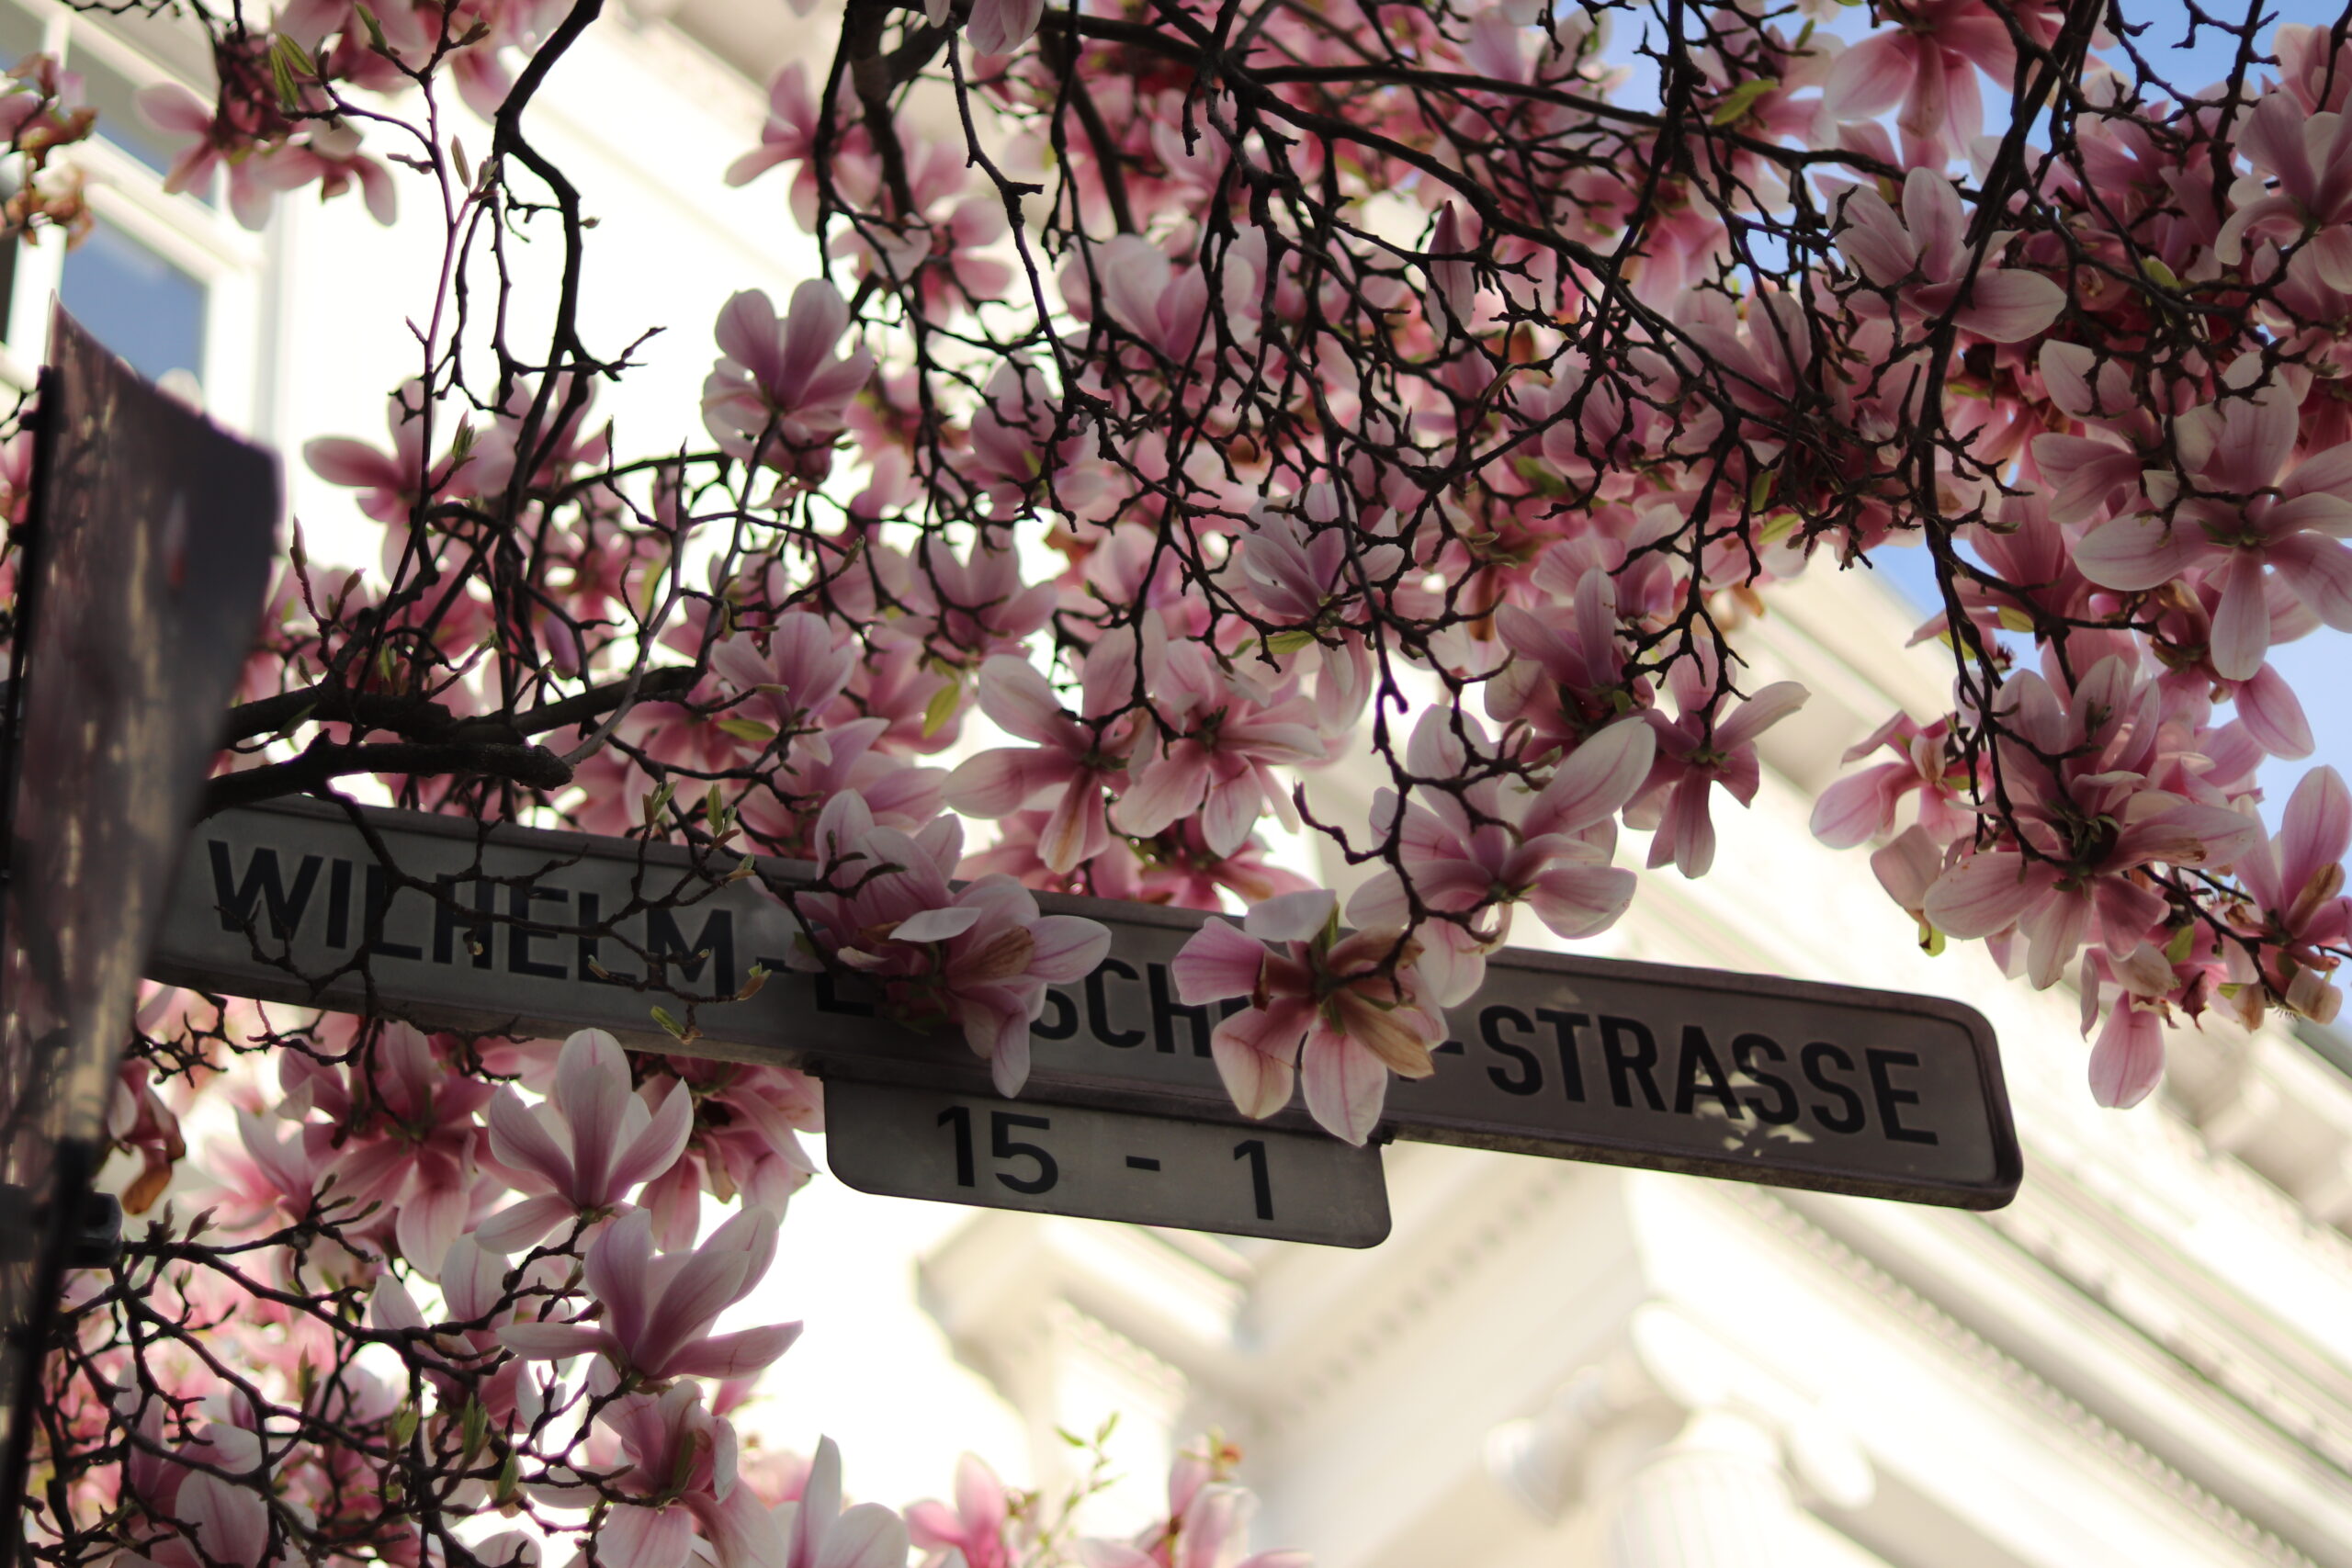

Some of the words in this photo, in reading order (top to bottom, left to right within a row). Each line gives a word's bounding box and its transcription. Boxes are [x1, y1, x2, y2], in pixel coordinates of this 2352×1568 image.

[936, 1105, 1059, 1195] 15
[1125, 1154, 1161, 1173] -
[1232, 1138, 1275, 1222] 1
